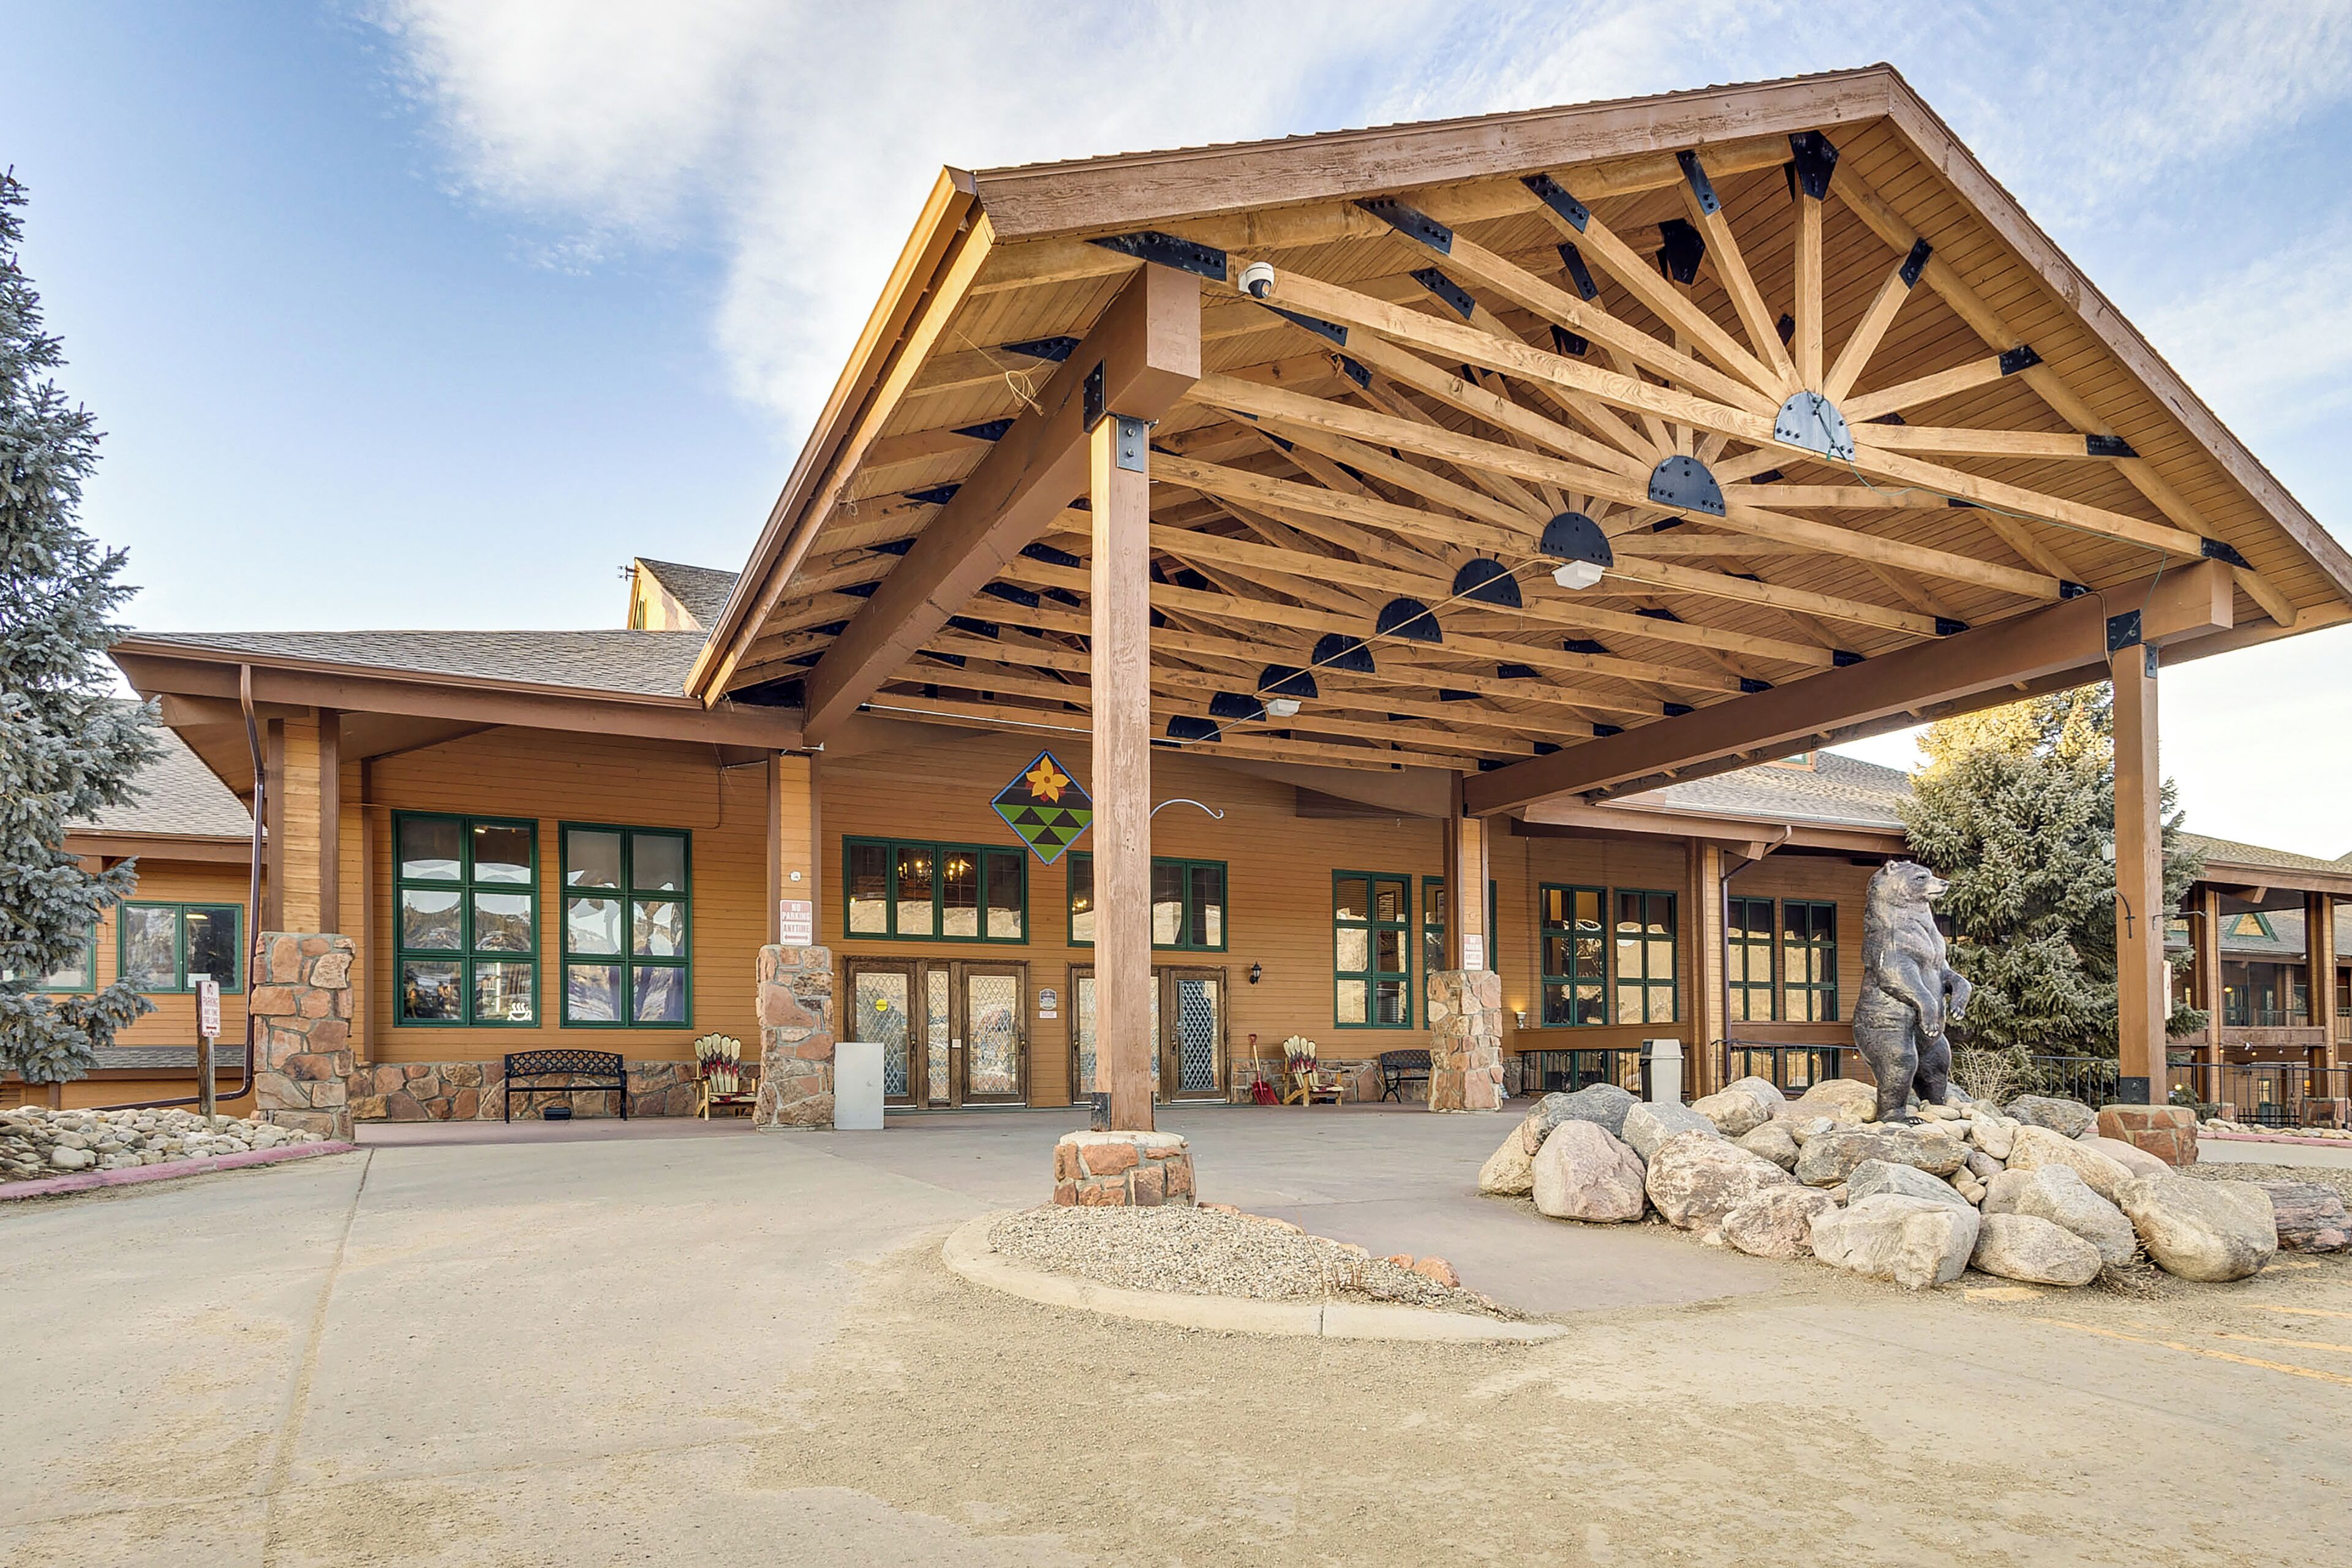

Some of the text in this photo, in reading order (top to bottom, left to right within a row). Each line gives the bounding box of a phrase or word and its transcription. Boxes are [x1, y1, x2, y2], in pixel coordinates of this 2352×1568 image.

[791, 903, 801, 912] NO
[782, 911, 811, 921] PARKING
[783, 924, 810, 933] ANYTIME
